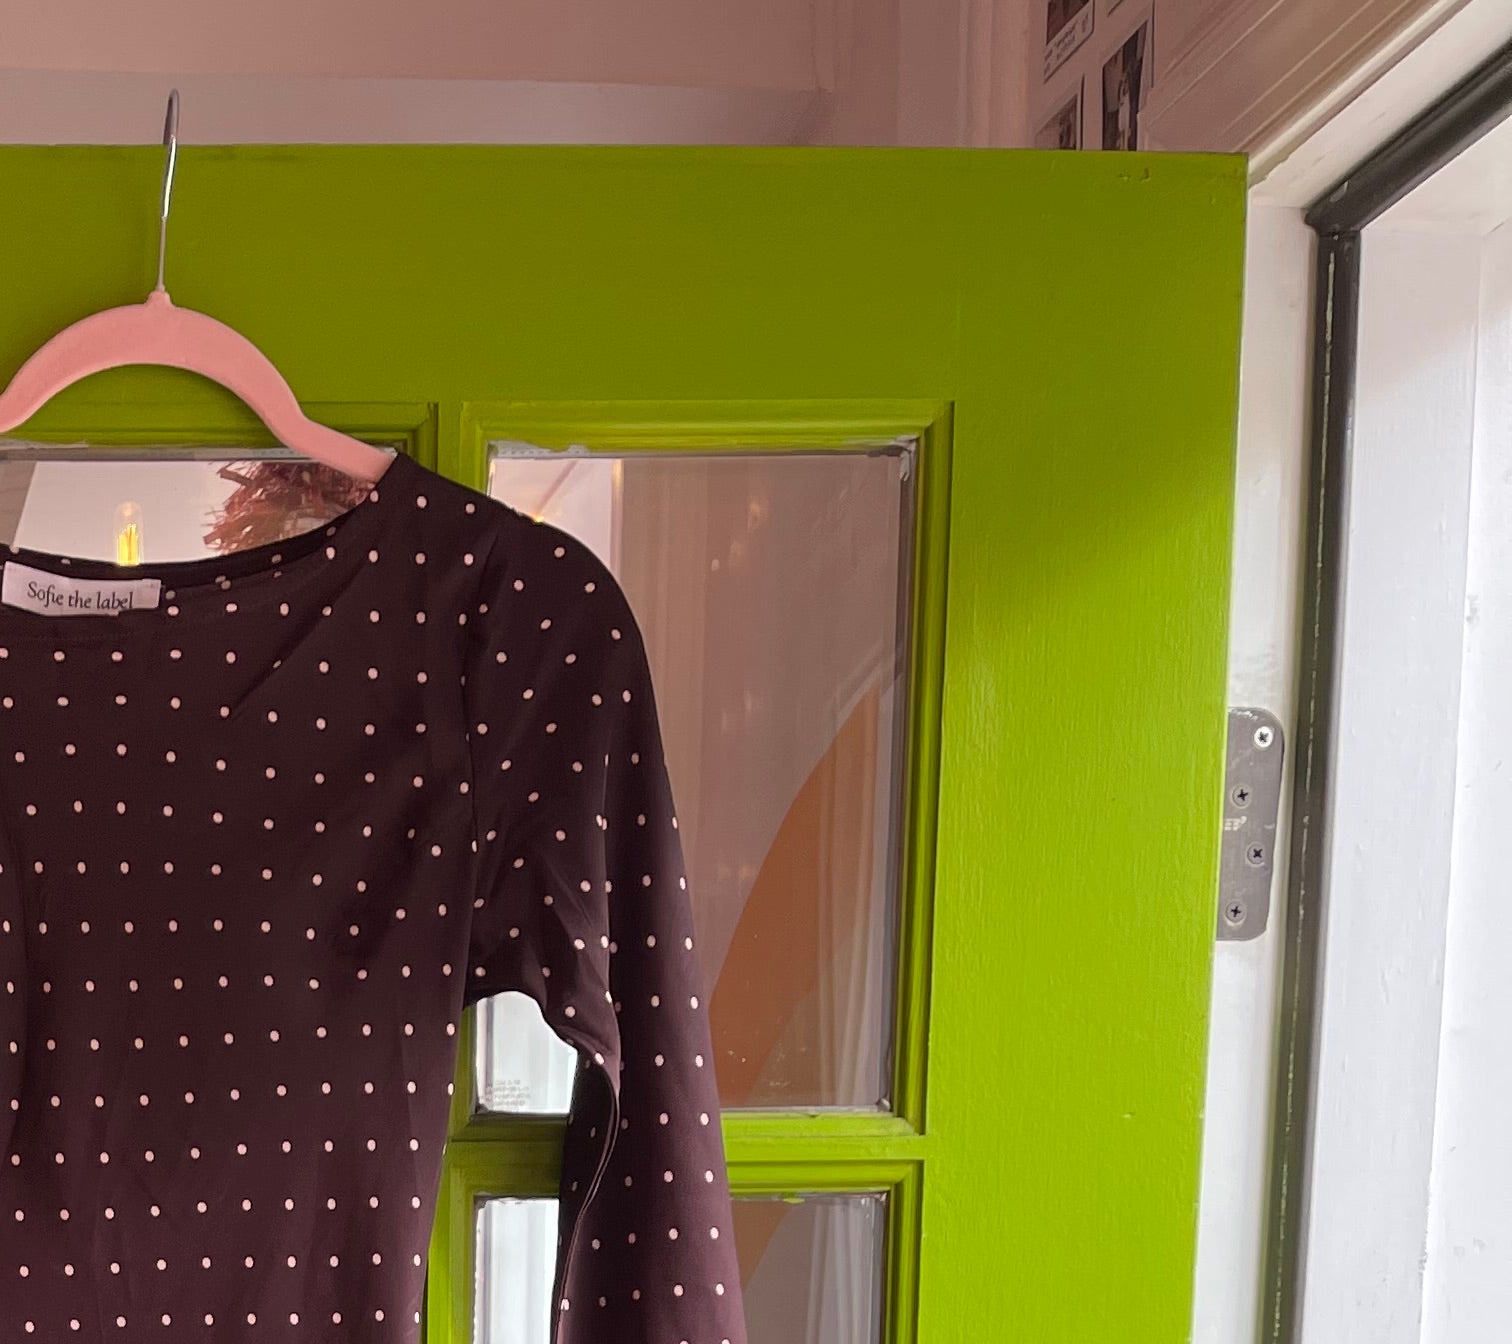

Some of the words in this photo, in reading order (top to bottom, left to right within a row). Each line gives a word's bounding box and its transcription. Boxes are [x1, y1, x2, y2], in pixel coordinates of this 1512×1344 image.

[27, 581, 64, 608] Sofie
[68, 590, 92, 609] the
[96, 591, 134, 610] label
